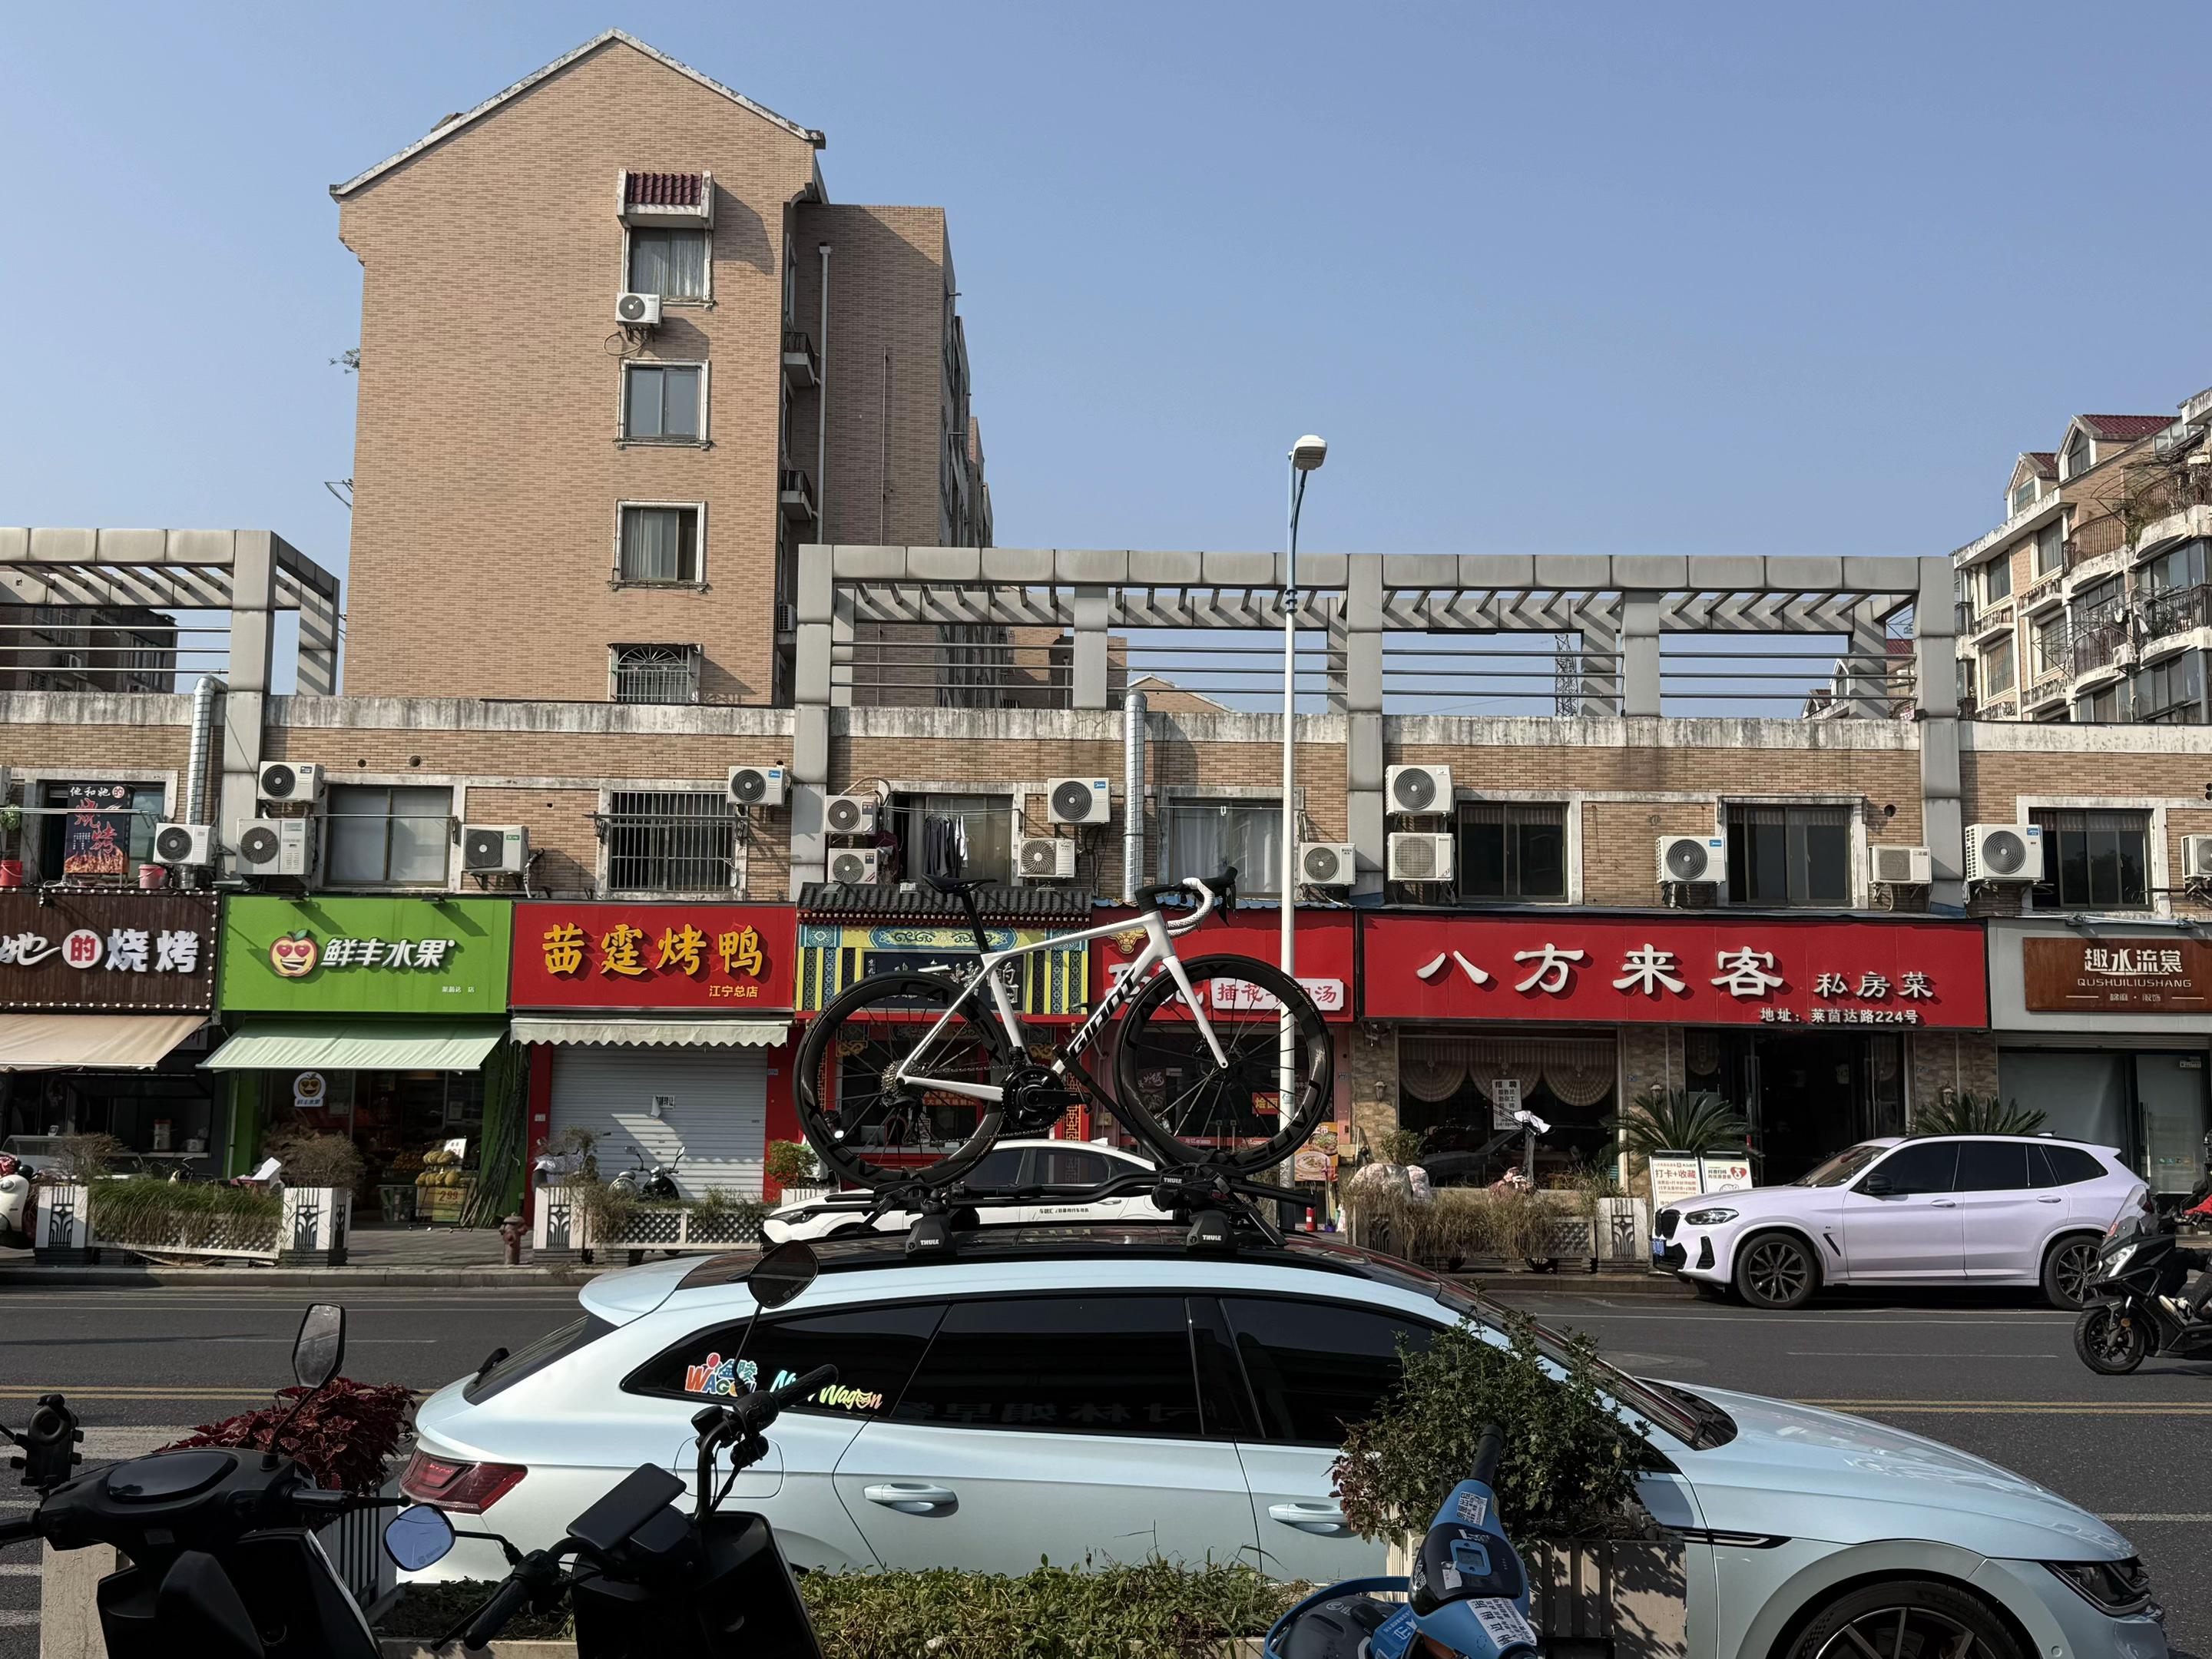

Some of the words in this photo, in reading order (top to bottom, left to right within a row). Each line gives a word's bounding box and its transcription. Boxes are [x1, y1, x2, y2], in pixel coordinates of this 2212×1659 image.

[70, 786, 124, 798] 他和她的
[75, 797, 118, 855] 烧烤
[320, 938, 449, 968] 鲜丰水果
[542, 922, 763, 976] 茜霆烤鸭
[2085, 948, 2184, 974] 趣水流裳
[1416, 942, 1784, 996] 八方来客
[1813, 971, 1934, 998] 私房菜
[2077, 978, 2191, 988] QUSHUILIUSHANG
[709, 985, 758, 998] 江宁总店
[1074, 966, 1138, 1055] GIANT
[1655, 1169, 1697, 1179] 打卡+收藏
